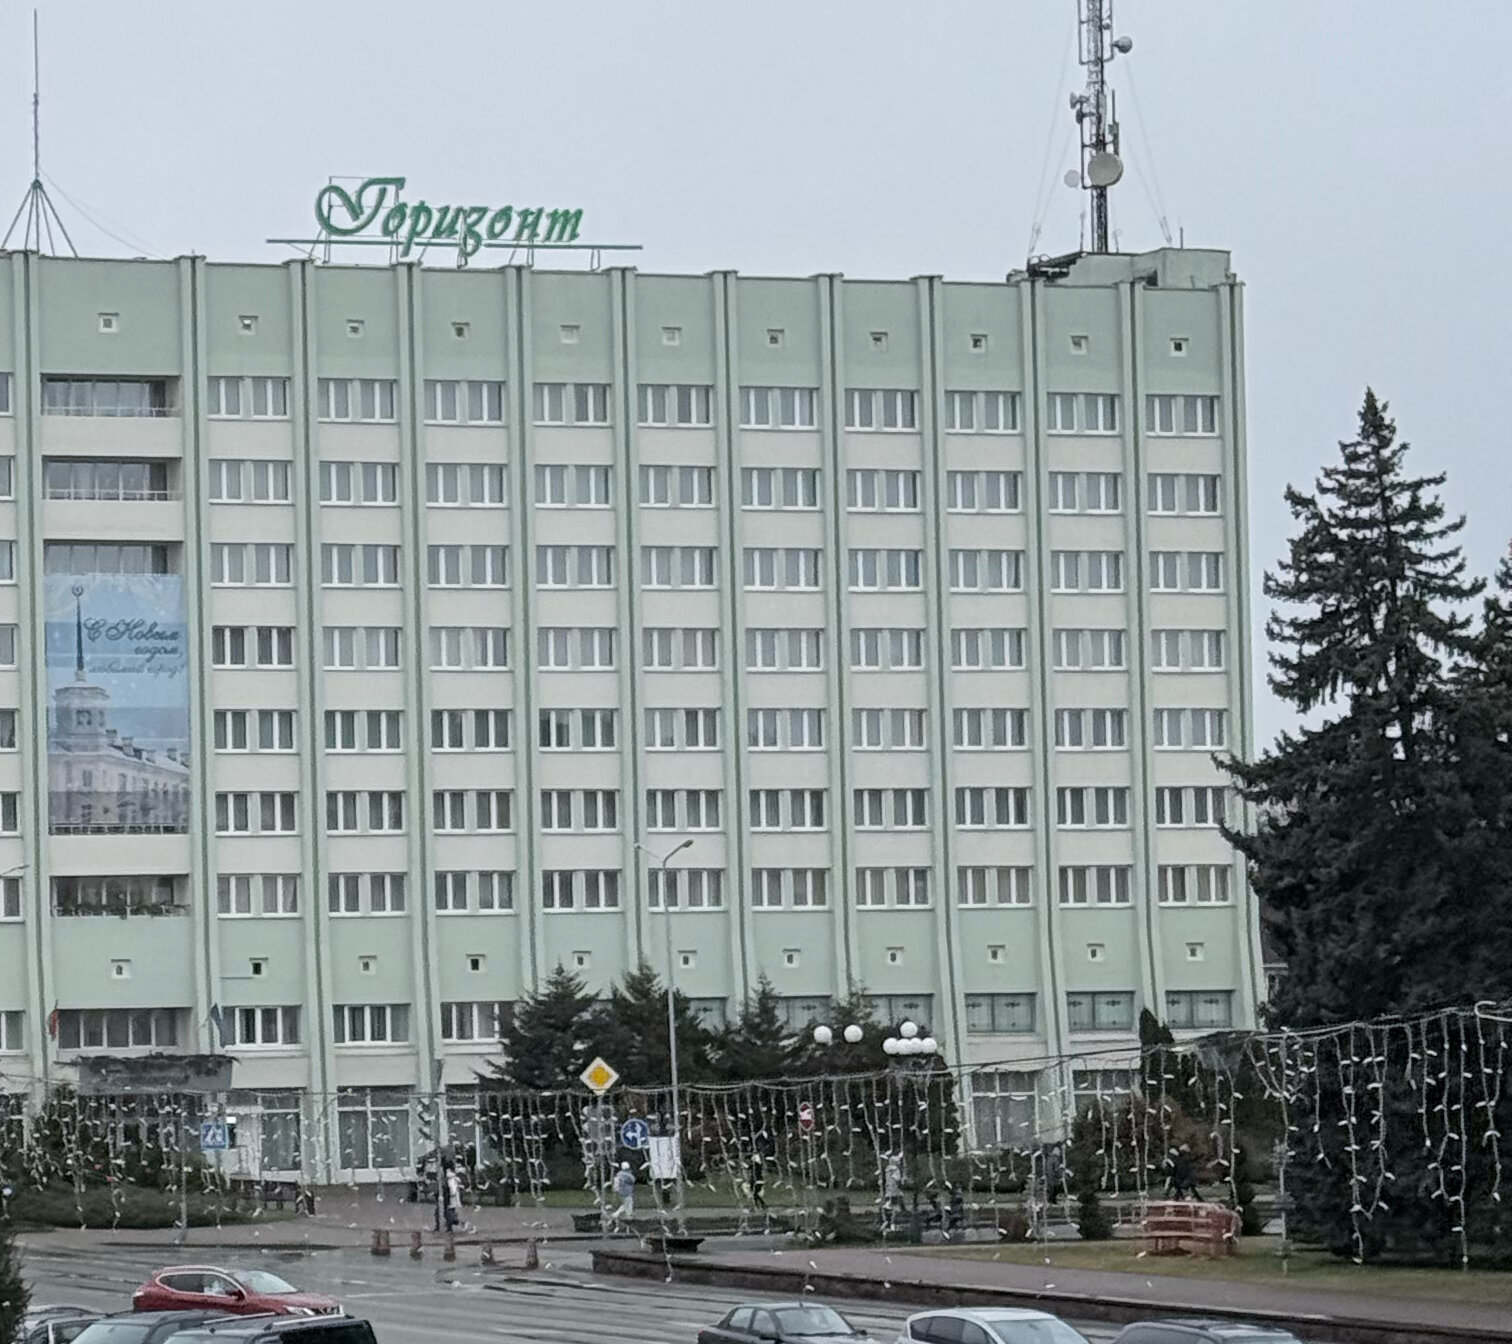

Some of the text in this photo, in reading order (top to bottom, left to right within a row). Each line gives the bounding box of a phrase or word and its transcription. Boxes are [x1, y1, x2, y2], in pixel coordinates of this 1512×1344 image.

[315, 177, 584, 258] Горизонт
[83, 617, 179, 642] С Новым
